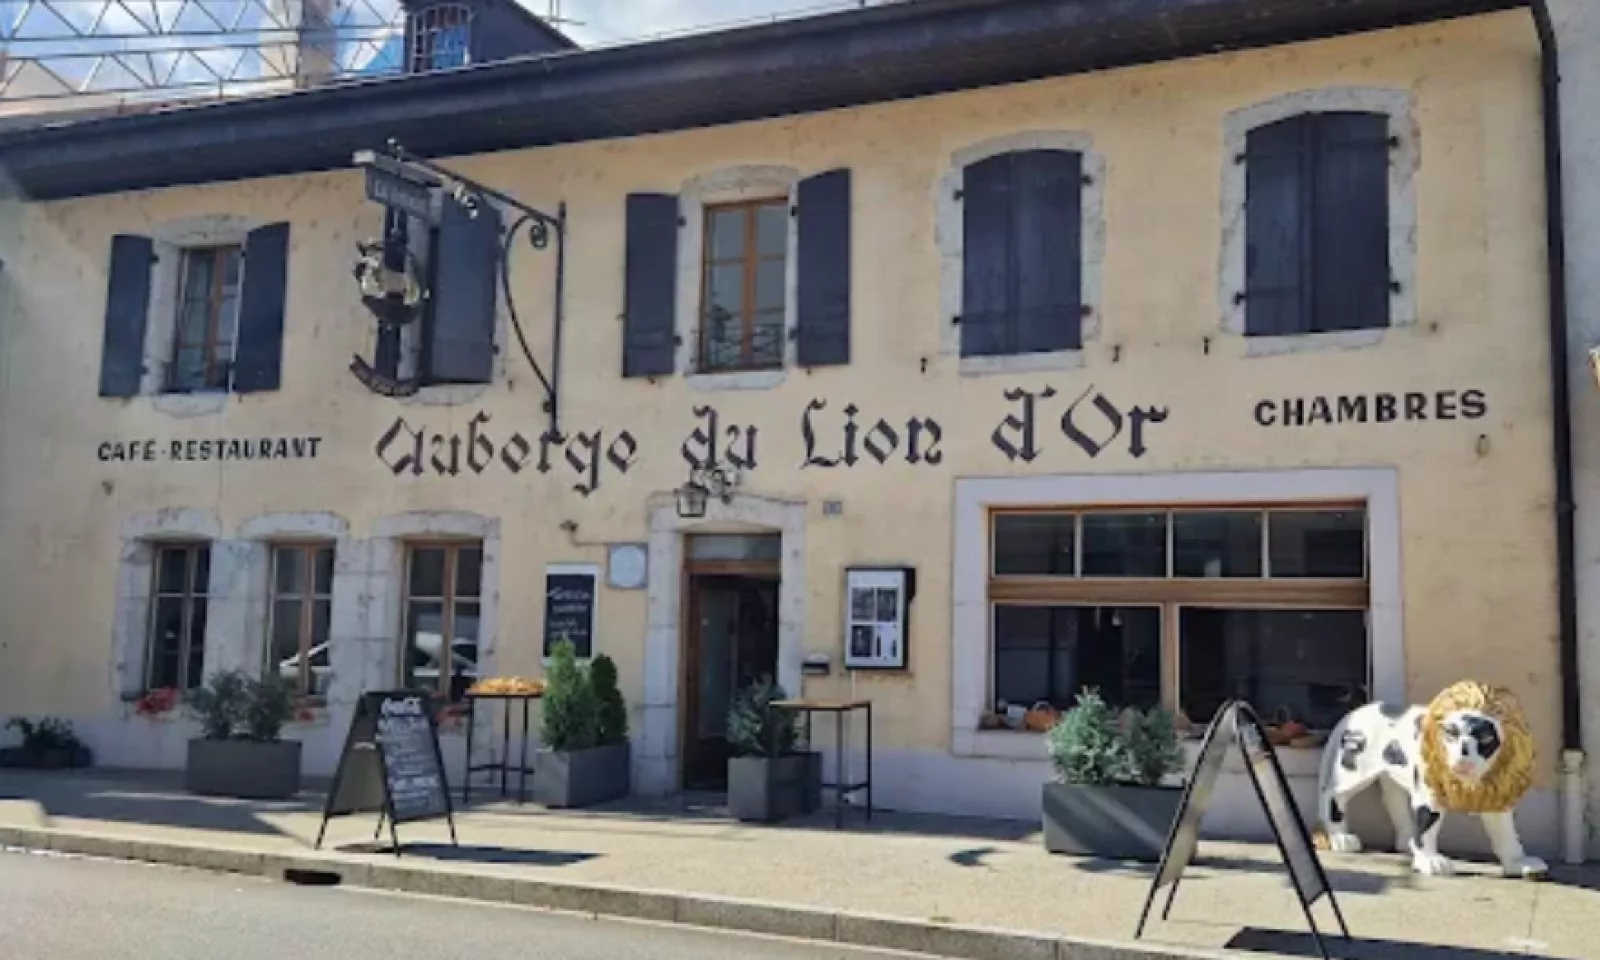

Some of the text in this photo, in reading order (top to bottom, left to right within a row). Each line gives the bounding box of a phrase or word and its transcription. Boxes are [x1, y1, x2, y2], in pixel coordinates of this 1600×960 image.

[375, 384, 1169, 497] Auberge du Lion d'Or
[1253, 389, 1488, 427] CHAMBRES
